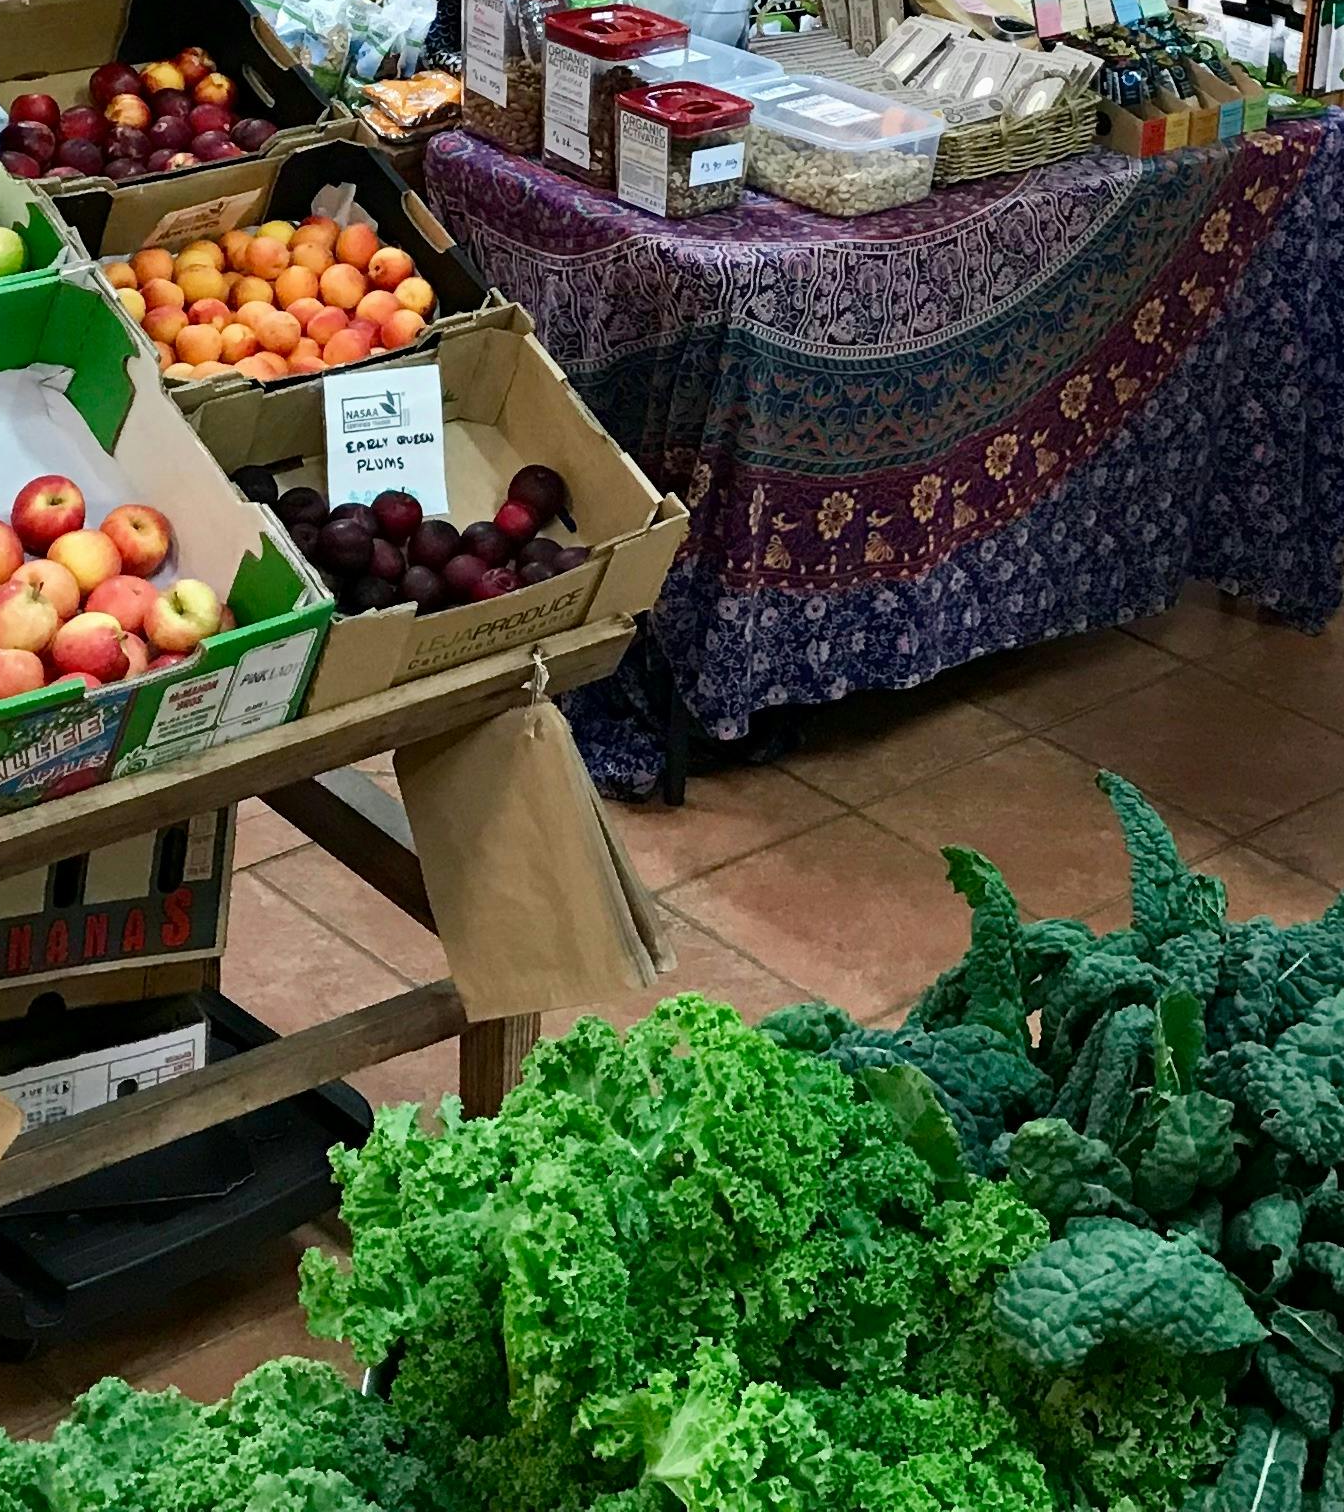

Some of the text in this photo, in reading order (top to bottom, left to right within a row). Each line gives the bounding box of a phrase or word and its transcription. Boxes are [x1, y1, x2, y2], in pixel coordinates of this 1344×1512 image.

[547, 44, 589, 67] ORGANIC
[548, 56, 589, 80] ACTIVATED
[622, 112, 666, 139] ORGANIC
[622, 126, 666, 149] ACTIVATED
[345, 407, 379, 420] NASAA
[345, 433, 435, 454] EARLY QUEEN
[356, 456, 405, 474] PLUMS
[17, 751, 108, 793] APPLES
